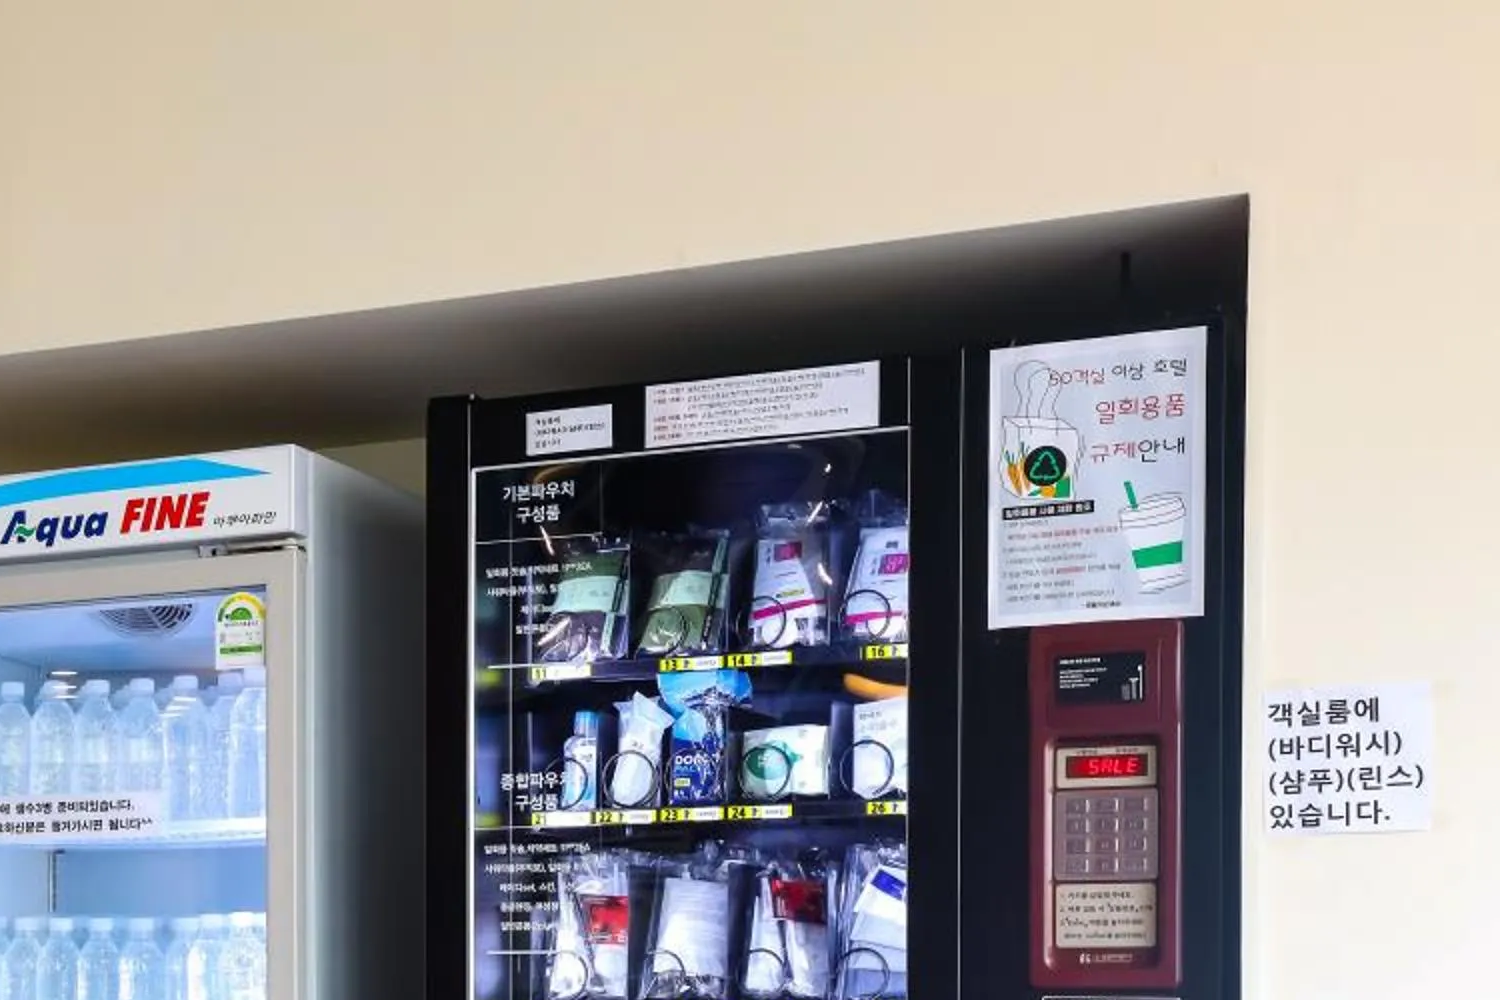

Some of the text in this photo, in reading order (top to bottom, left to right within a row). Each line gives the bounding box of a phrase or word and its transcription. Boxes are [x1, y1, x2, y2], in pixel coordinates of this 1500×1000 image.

[1111, 362, 1145, 382] 이상
[1153, 357, 1188, 377] 호텔
[1095, 391, 1187, 426] 일회용품
[502, 479, 576, 503] 기본파우치
[0, 509, 109, 547] Aqua
[119, 491, 211, 535] FINE
[516, 503, 561, 525] 구성품
[1268, 696, 1380, 728] 객실룸에
[1268, 729, 1403, 762] (바디워시)
[1088, 756, 1140, 776] SALE
[1268, 764, 1425, 796] (샴푸)(린스)
[515, 794, 559, 812] 구성품
[664, 809, 677, 821] 23
[732, 807, 746, 819] 24
[1269, 799, 1391, 830] 있습니다.
